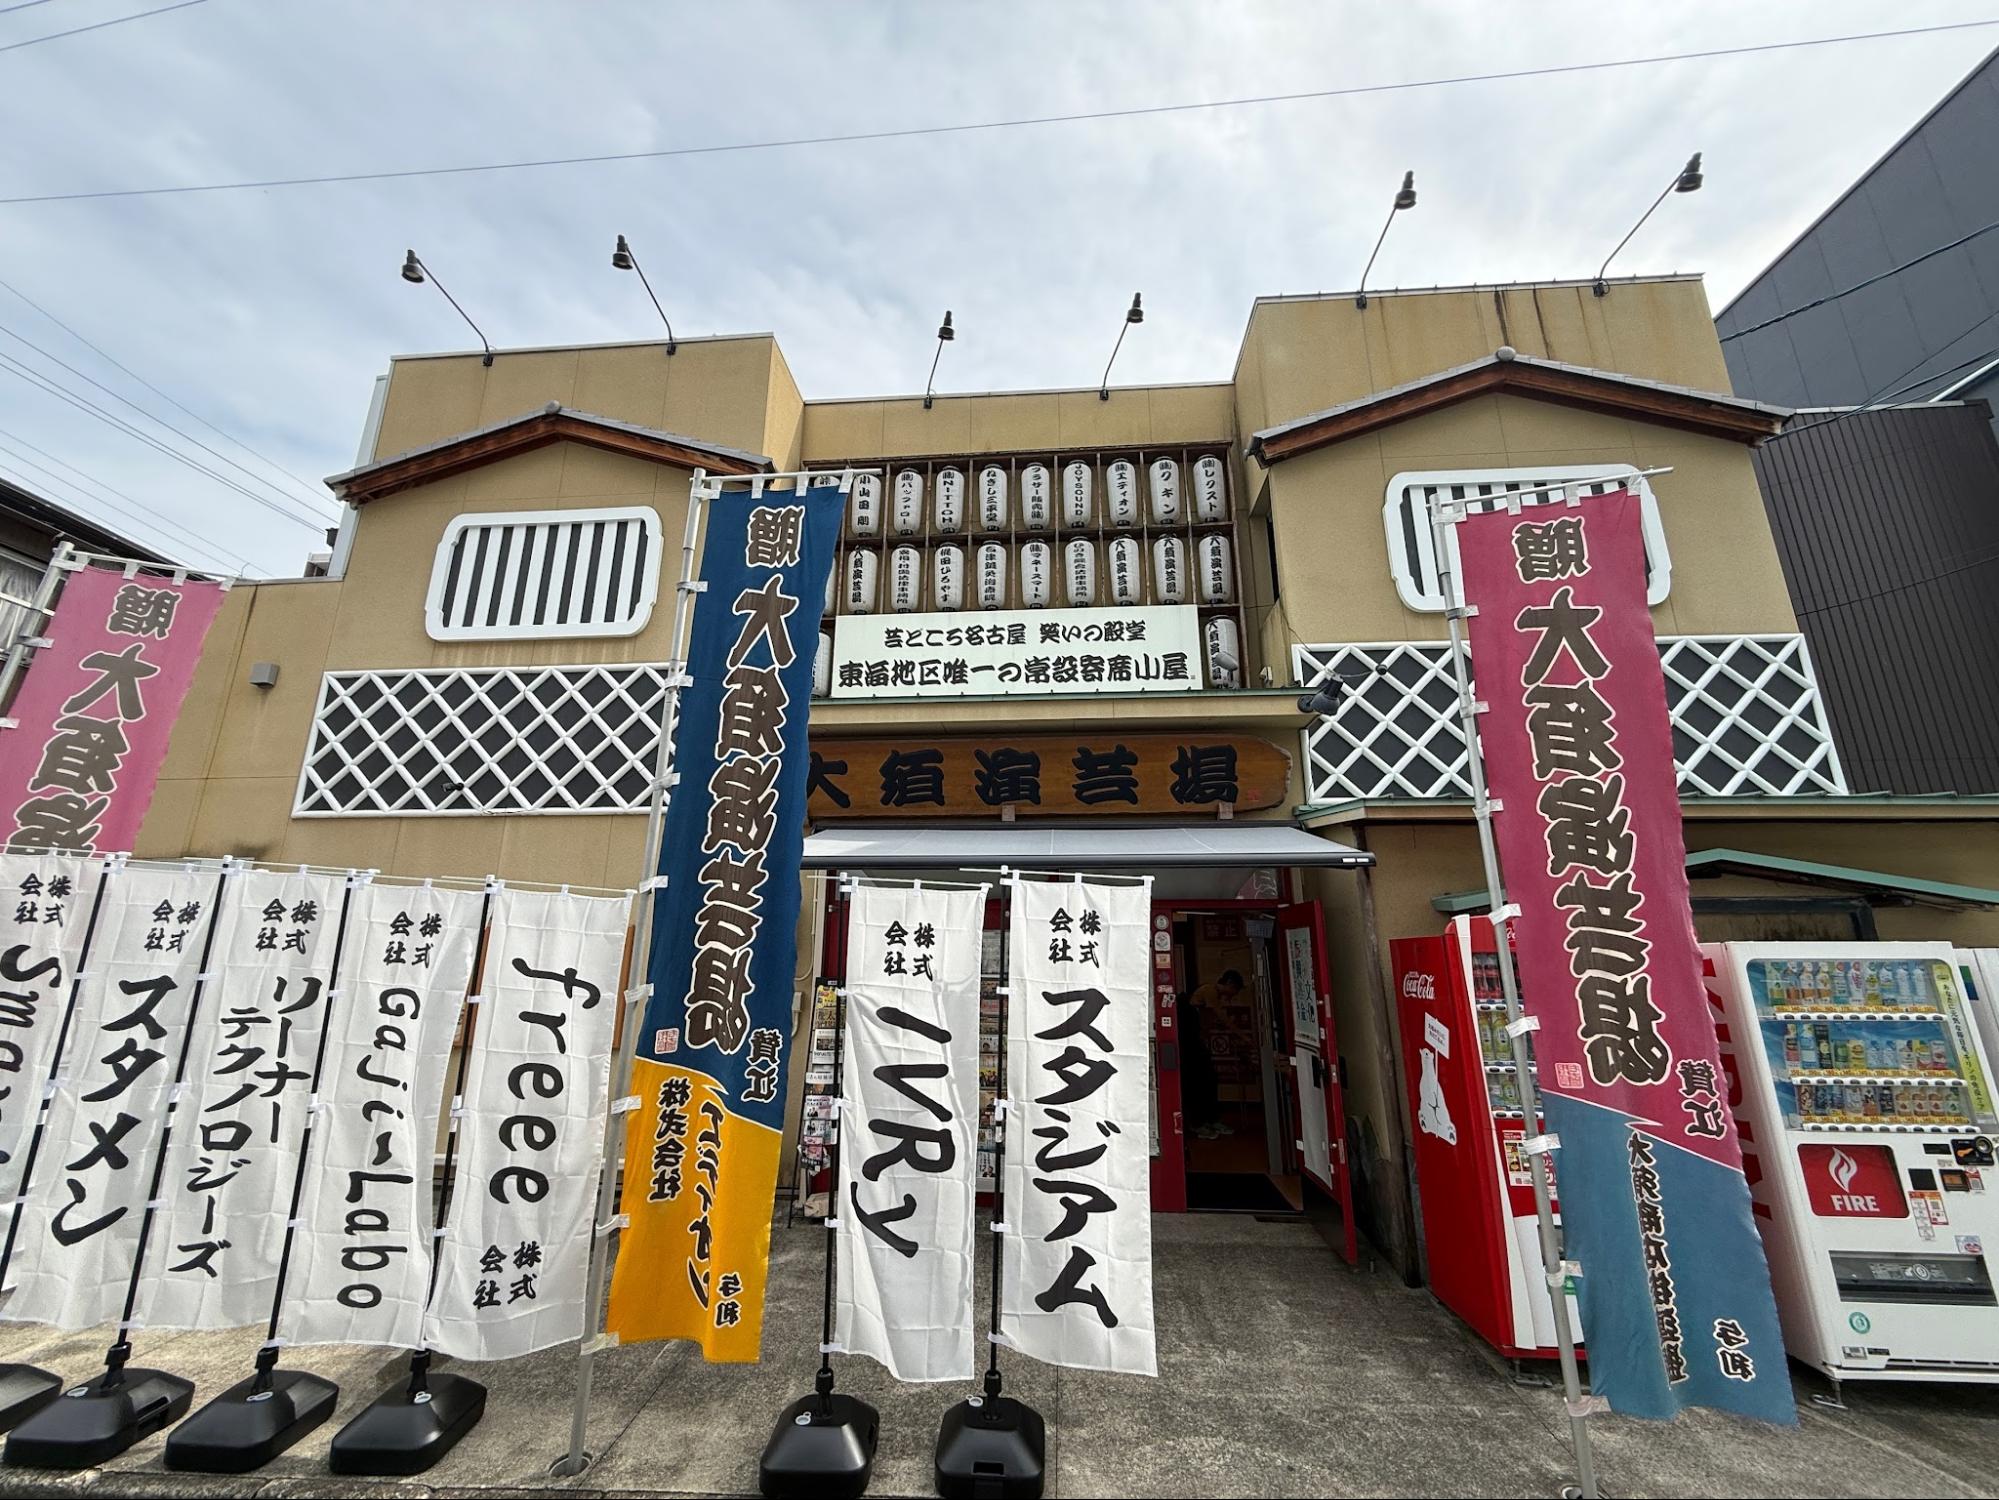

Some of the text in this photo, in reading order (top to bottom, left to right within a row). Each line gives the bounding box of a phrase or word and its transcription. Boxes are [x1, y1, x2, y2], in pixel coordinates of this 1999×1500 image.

[1074, 463, 1084, 516] JOYSOUND
[884, 622, 1027, 648] 芸どころ名古屋
[806, 744, 1240, 807] 大須演芸場
[51, 975, 178, 1246] スタメン
[168, 1007, 272, 1278] テクノロジーズ
[336, 987, 421, 1309] Gaji-Labo
[489, 957, 602, 1206] freee
[1033, 988, 1121, 1329] スタジアム
[1830, 1194, 1881, 1213] FIRE
